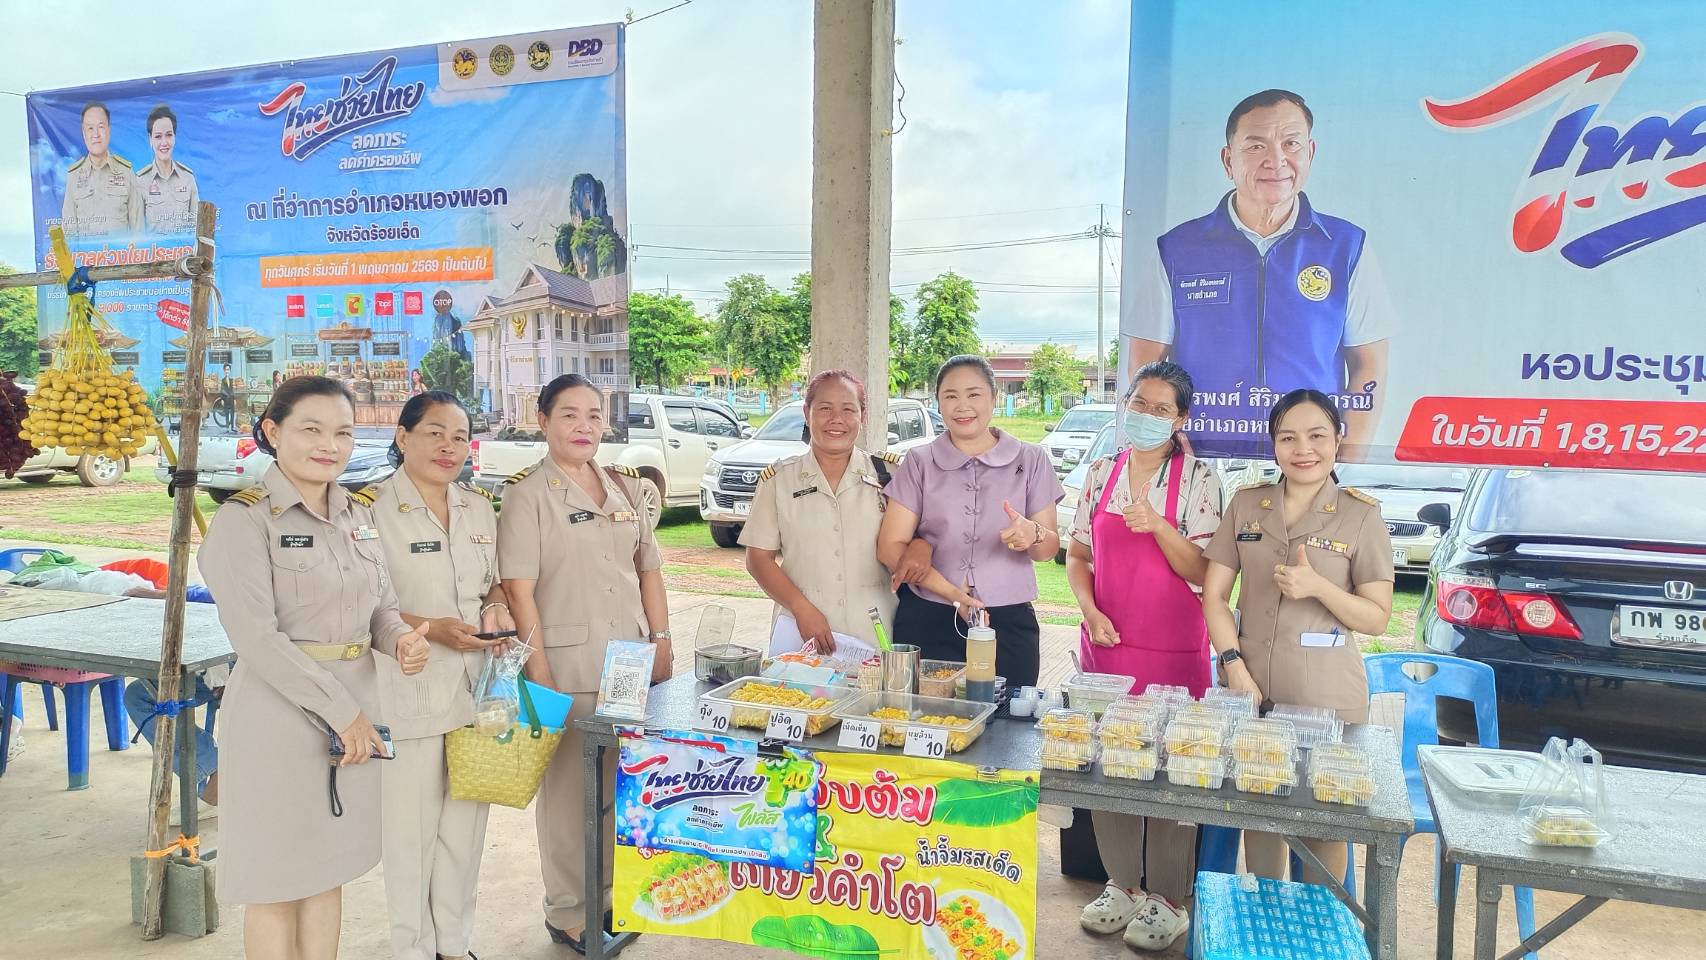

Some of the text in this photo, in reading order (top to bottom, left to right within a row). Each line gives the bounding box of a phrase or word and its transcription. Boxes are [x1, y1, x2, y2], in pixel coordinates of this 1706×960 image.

[568, 38, 603, 57] DBD
[259, 56, 425, 157] ไทยช่วยไทย
[352, 132, 407, 149] ลดภาระ
[339, 151, 421, 170] ลดค่าครองชีพ
[247, 202, 267, 220] ณ
[273, 187, 508, 219] ที่ว่าการอำเภอหนองพอก
[327, 221, 420, 242] จังหวัดร้อยเอ็ด
[265, 256, 487, 281] ทุกวันศุกร์ เริ่มวันที่ 1 พฤษภาคม 2569 เป็นต้นไป
[1431, 409, 1548, 449] ในวันที่
[1631, 611, 1706, 632] กพ 98
[700, 703, 713, 720] กุ้ง
[771, 712, 792, 727] ปูอัด
[712, 715, 727, 729] 10
[787, 725, 802, 739] 10
[860, 733, 875, 748] 10
[926, 741, 943, 756] 10
[622, 755, 766, 805] ไทยช่วยไทย
[783, 770, 807, 790] 40
[916, 836, 1022, 884] น้ำจิ้มรสเด็ด
